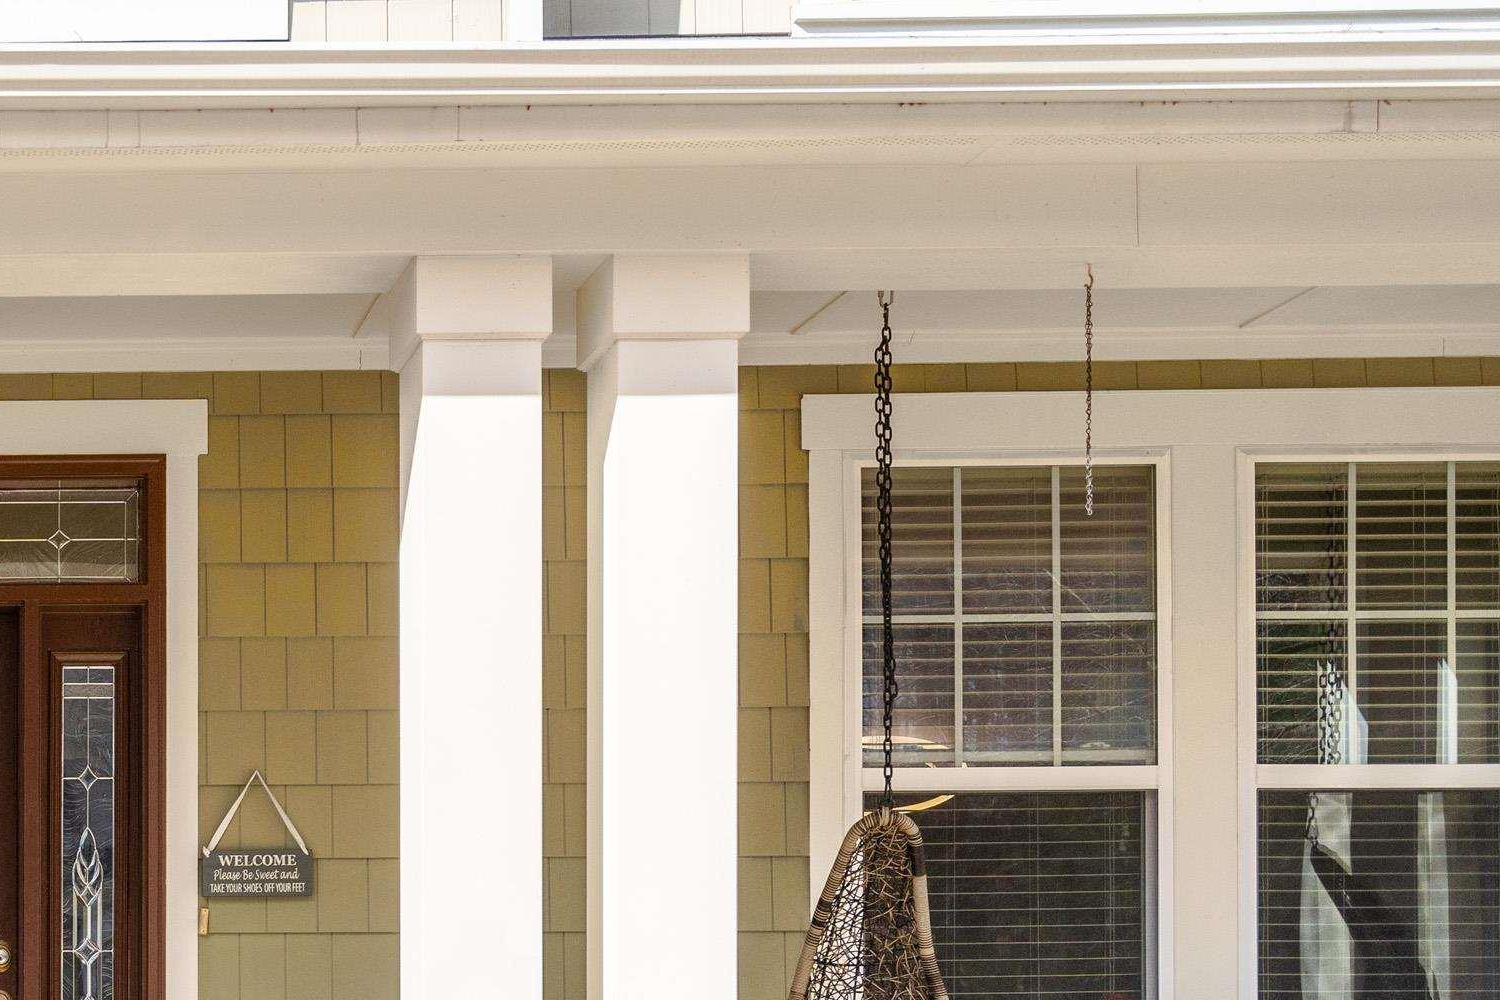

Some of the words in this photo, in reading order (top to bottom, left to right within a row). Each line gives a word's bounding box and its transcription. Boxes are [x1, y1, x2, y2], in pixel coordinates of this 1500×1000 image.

[218, 854, 297, 867] WELCOME
[213, 868, 241, 881] Please
[242, 869, 254, 880] Be
[255, 869, 279, 880] Sweet
[280, 867, 300, 880] and
[210, 883, 226, 893] TAKE
[226, 883, 242, 893] YOUR
[243, 883, 263, 893] SHOES
[264, 883, 275, 893] OFF
[276, 883, 292, 893] YOUR
[292, 882, 306, 893] FEET
